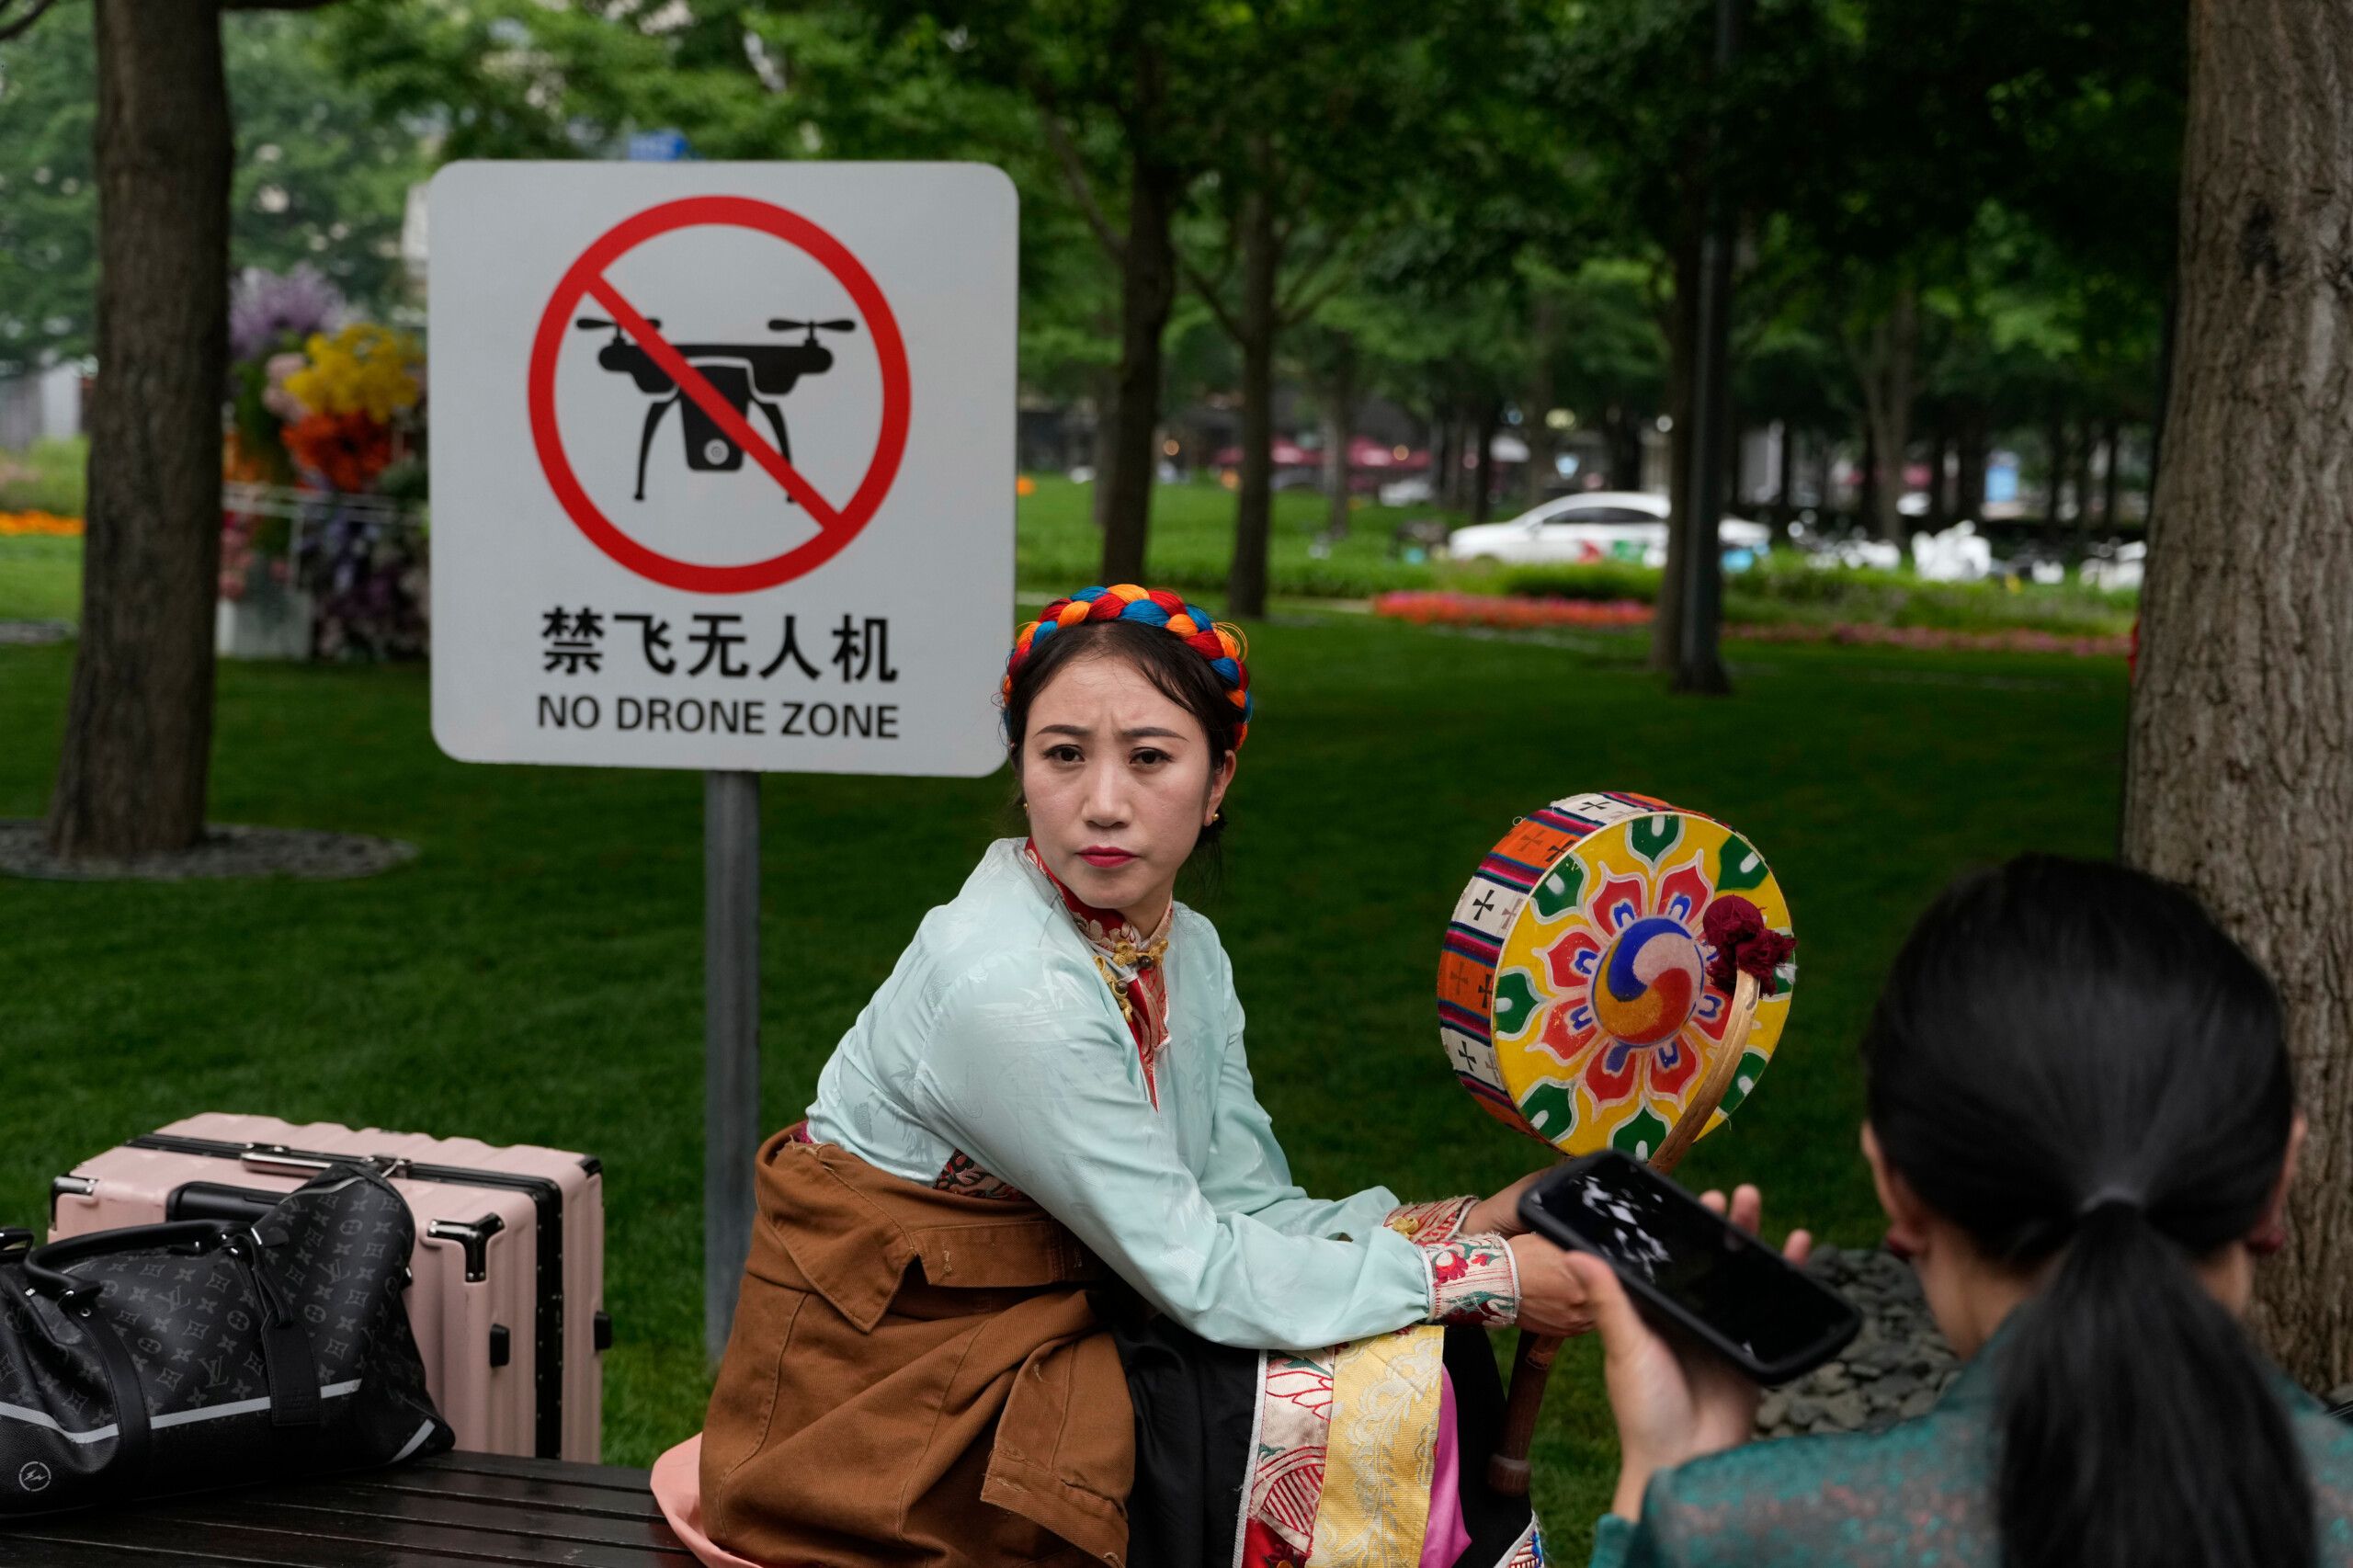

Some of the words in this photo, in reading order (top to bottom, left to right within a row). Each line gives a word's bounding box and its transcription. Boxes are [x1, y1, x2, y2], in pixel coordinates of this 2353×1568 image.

[540, 606, 899, 684] 禁飞无人机
[539, 695, 600, 729] NO
[617, 697, 765, 734] DRONE
[780, 701, 899, 739] ZONE
